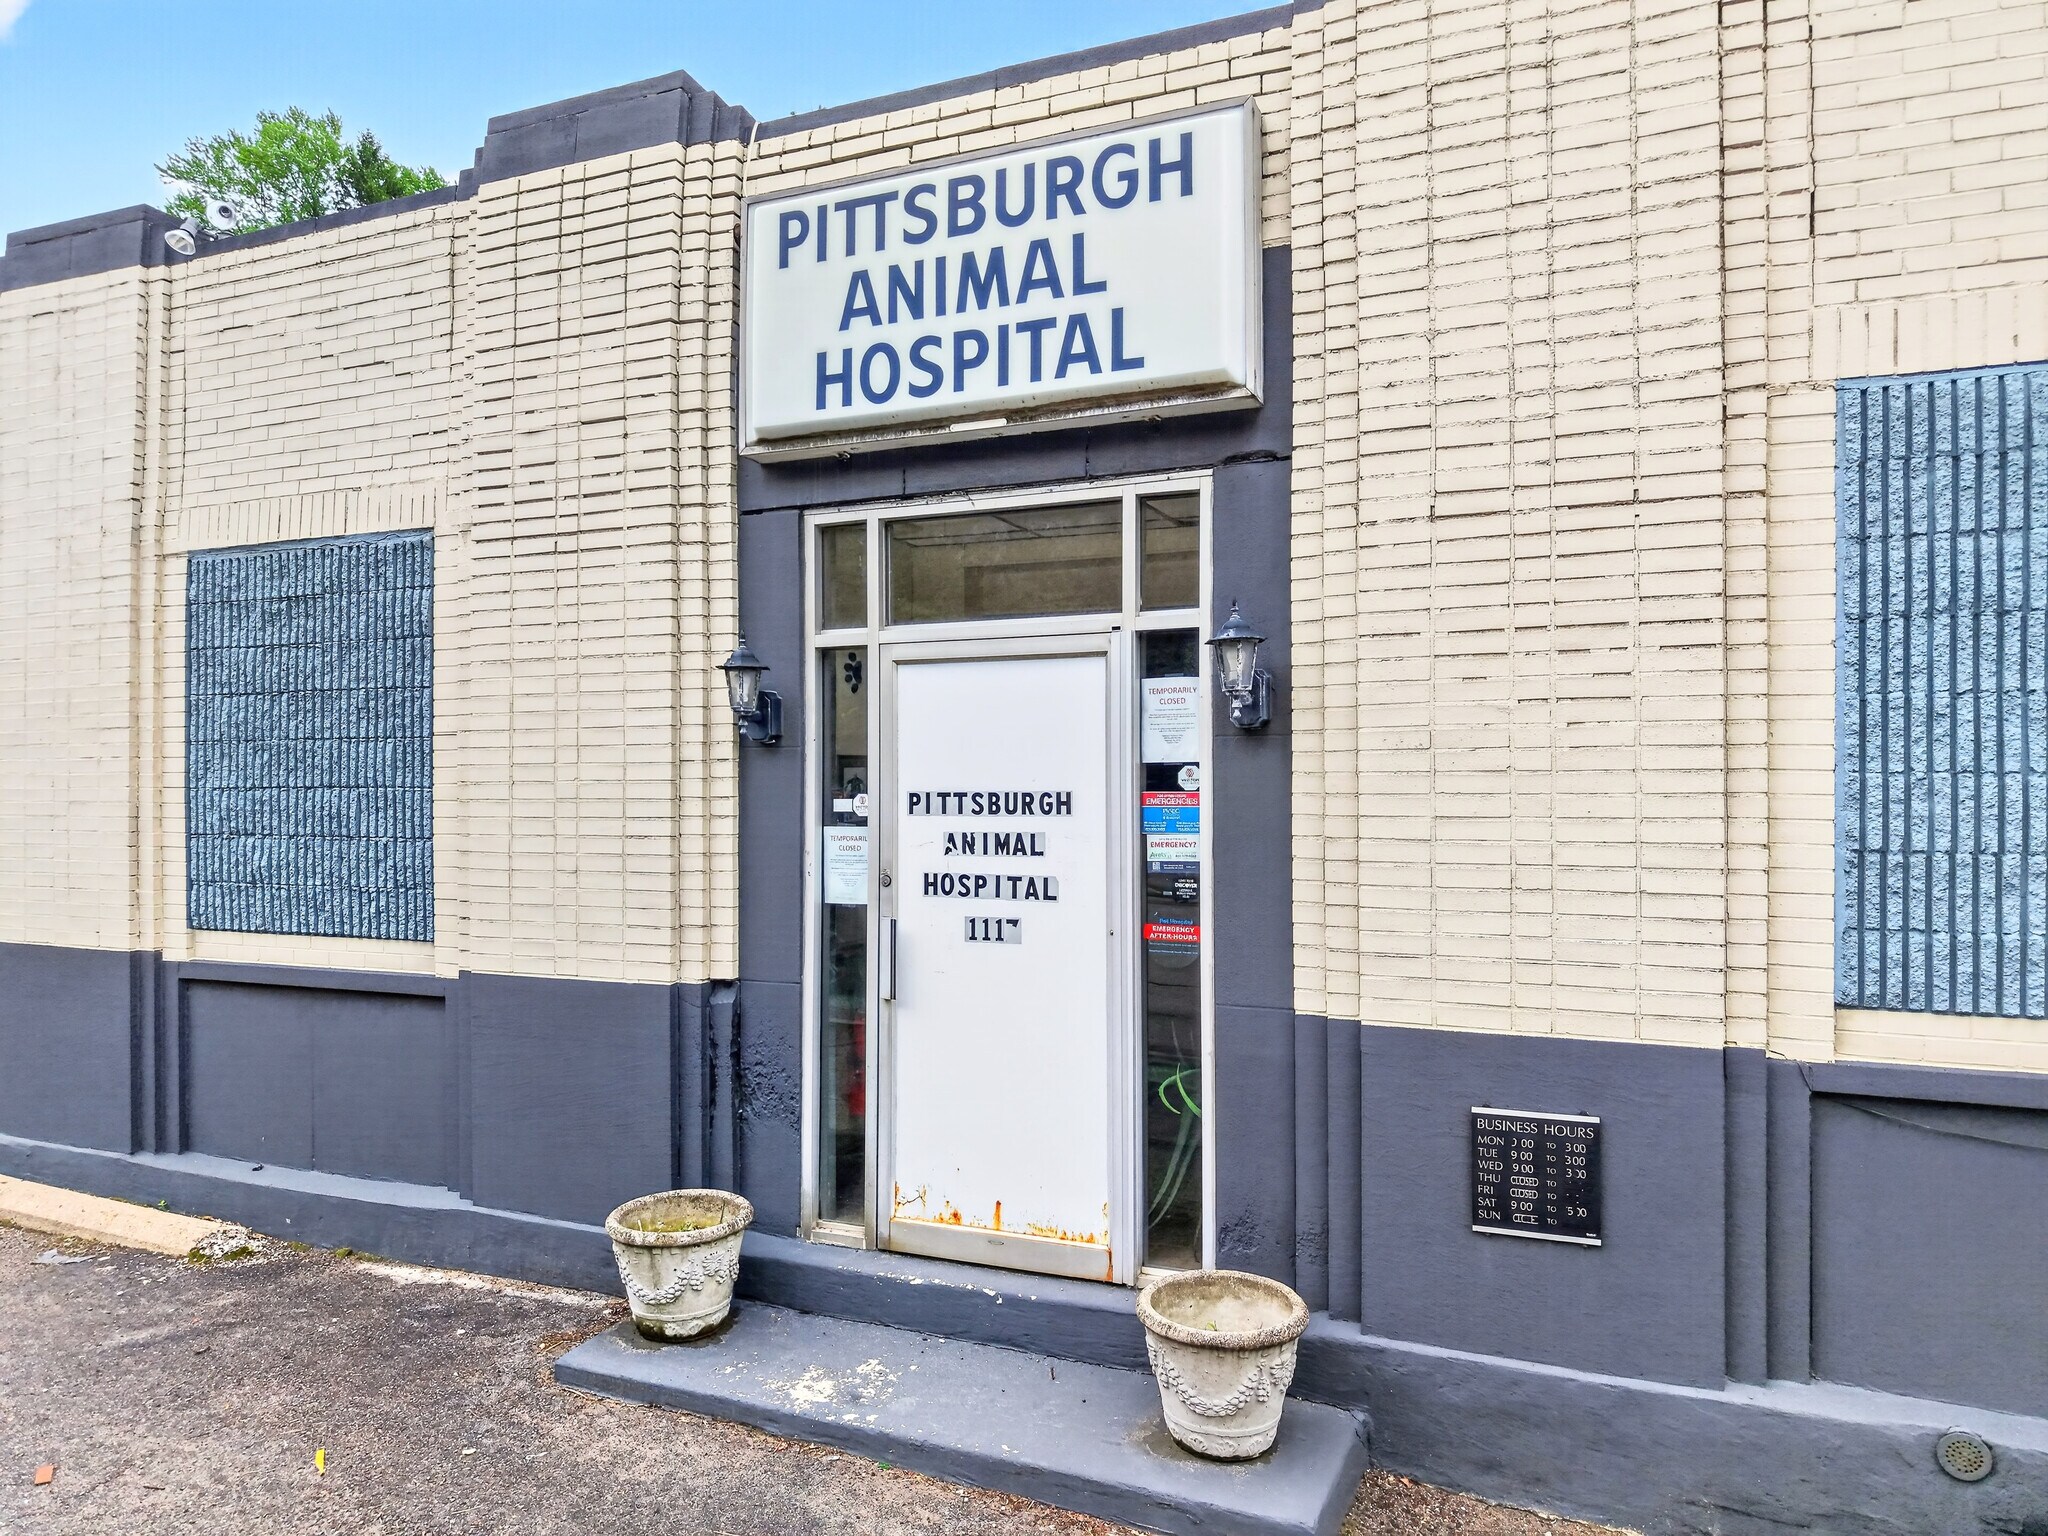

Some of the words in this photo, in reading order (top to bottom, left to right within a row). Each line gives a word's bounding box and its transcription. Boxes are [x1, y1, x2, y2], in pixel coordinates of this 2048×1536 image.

[779, 132, 1194, 270] PITTSBURGH
[838, 232, 1108, 331] ANIMAL
[815, 307, 1145, 411] HOSPITAL
[1148, 686, 1197, 695] TEMPORARILY
[1159, 697, 1186, 705] CLOSED
[908, 791, 1072, 816] PITTSBURGH
[1146, 797, 1198, 805] EMERGENCIES
[838, 844, 861, 852] CLOSED
[944, 832, 1044, 856] ANIMAL
[924, 873, 1058, 901] HOSPITAL
[1152, 925, 1195, 933] EMERGENCY
[1477, 1118, 1538, 1134] BUSINESS
[1544, 1124, 1594, 1139] HOURS
[1477, 1136, 1505, 1146] MON
[1546, 1142, 1556, 1150] TO
[1478, 1147, 1498, 1158] TUE
[1478, 1160, 1503, 1171] WED
[1546, 1167, 1556, 1175] TO
[1478, 1172, 1501, 1183] THU
[1510, 1176, 1539, 1187] CLOSED
[1477, 1185, 1494, 1195] FRI
[1510, 1188, 1538, 1199] CLOSED
[1478, 1197, 1497, 1207] SAT
[1546, 1205, 1556, 1213] TO
[1478, 1209, 1501, 1220] SUN
